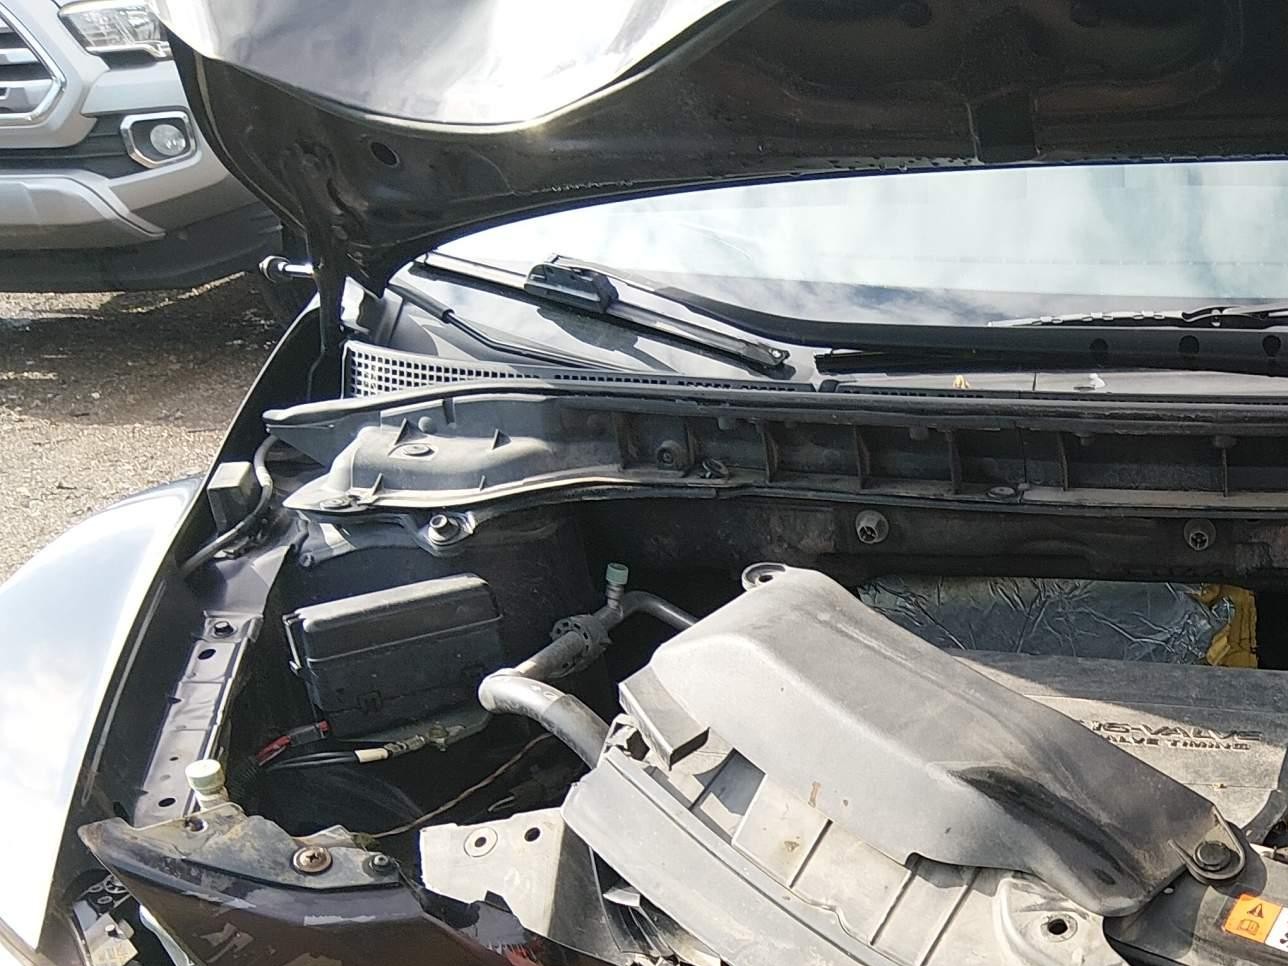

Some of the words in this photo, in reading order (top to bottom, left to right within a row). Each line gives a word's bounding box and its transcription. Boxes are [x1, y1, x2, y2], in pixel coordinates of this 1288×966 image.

[1091, 720, 1264, 742] 16-VALVE
[1107, 735, 1160, 746] ALVE
[1166, 739, 1251, 751] TIMING
